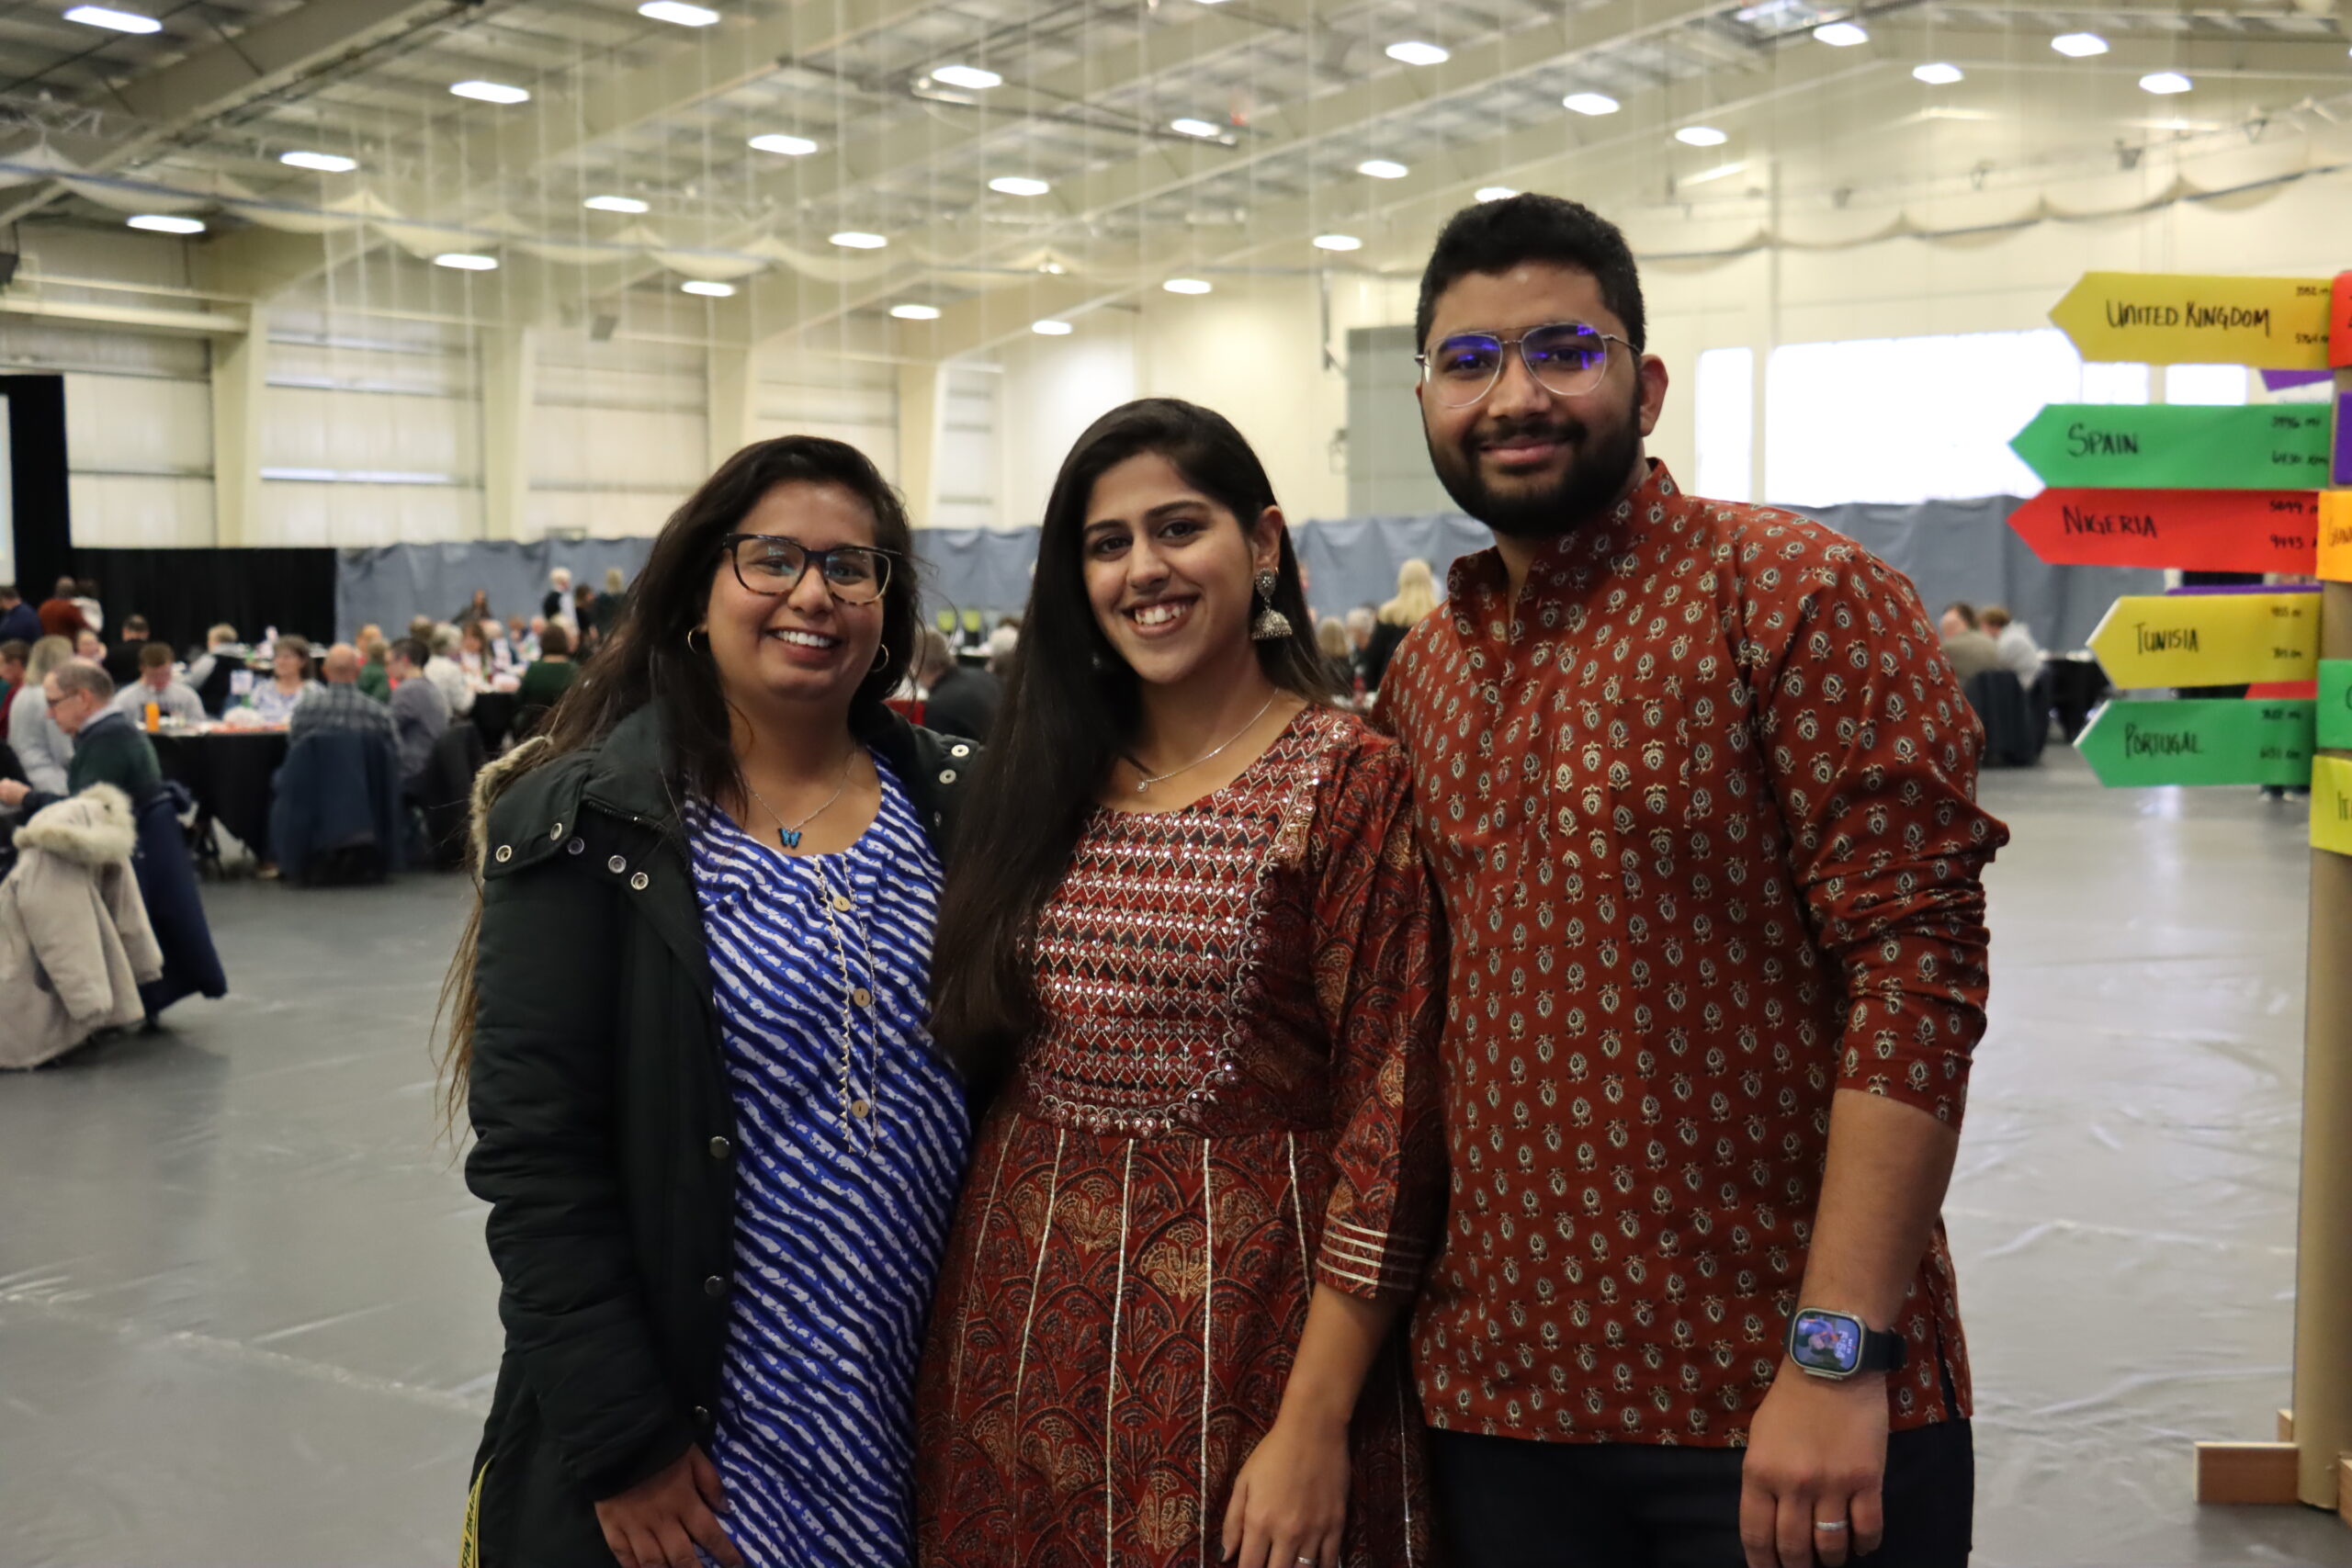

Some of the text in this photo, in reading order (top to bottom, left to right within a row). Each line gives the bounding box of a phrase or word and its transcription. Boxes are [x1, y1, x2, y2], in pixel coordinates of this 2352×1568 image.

[2185, 300, 2271, 338] KINGDOM
[2066, 422, 2139, 457] SPAIN
[2062, 504, 2158, 539] NIGERIA
[2133, 621, 2199, 655] TUNISIA
[2124, 722, 2204, 760] PORTUGAL
